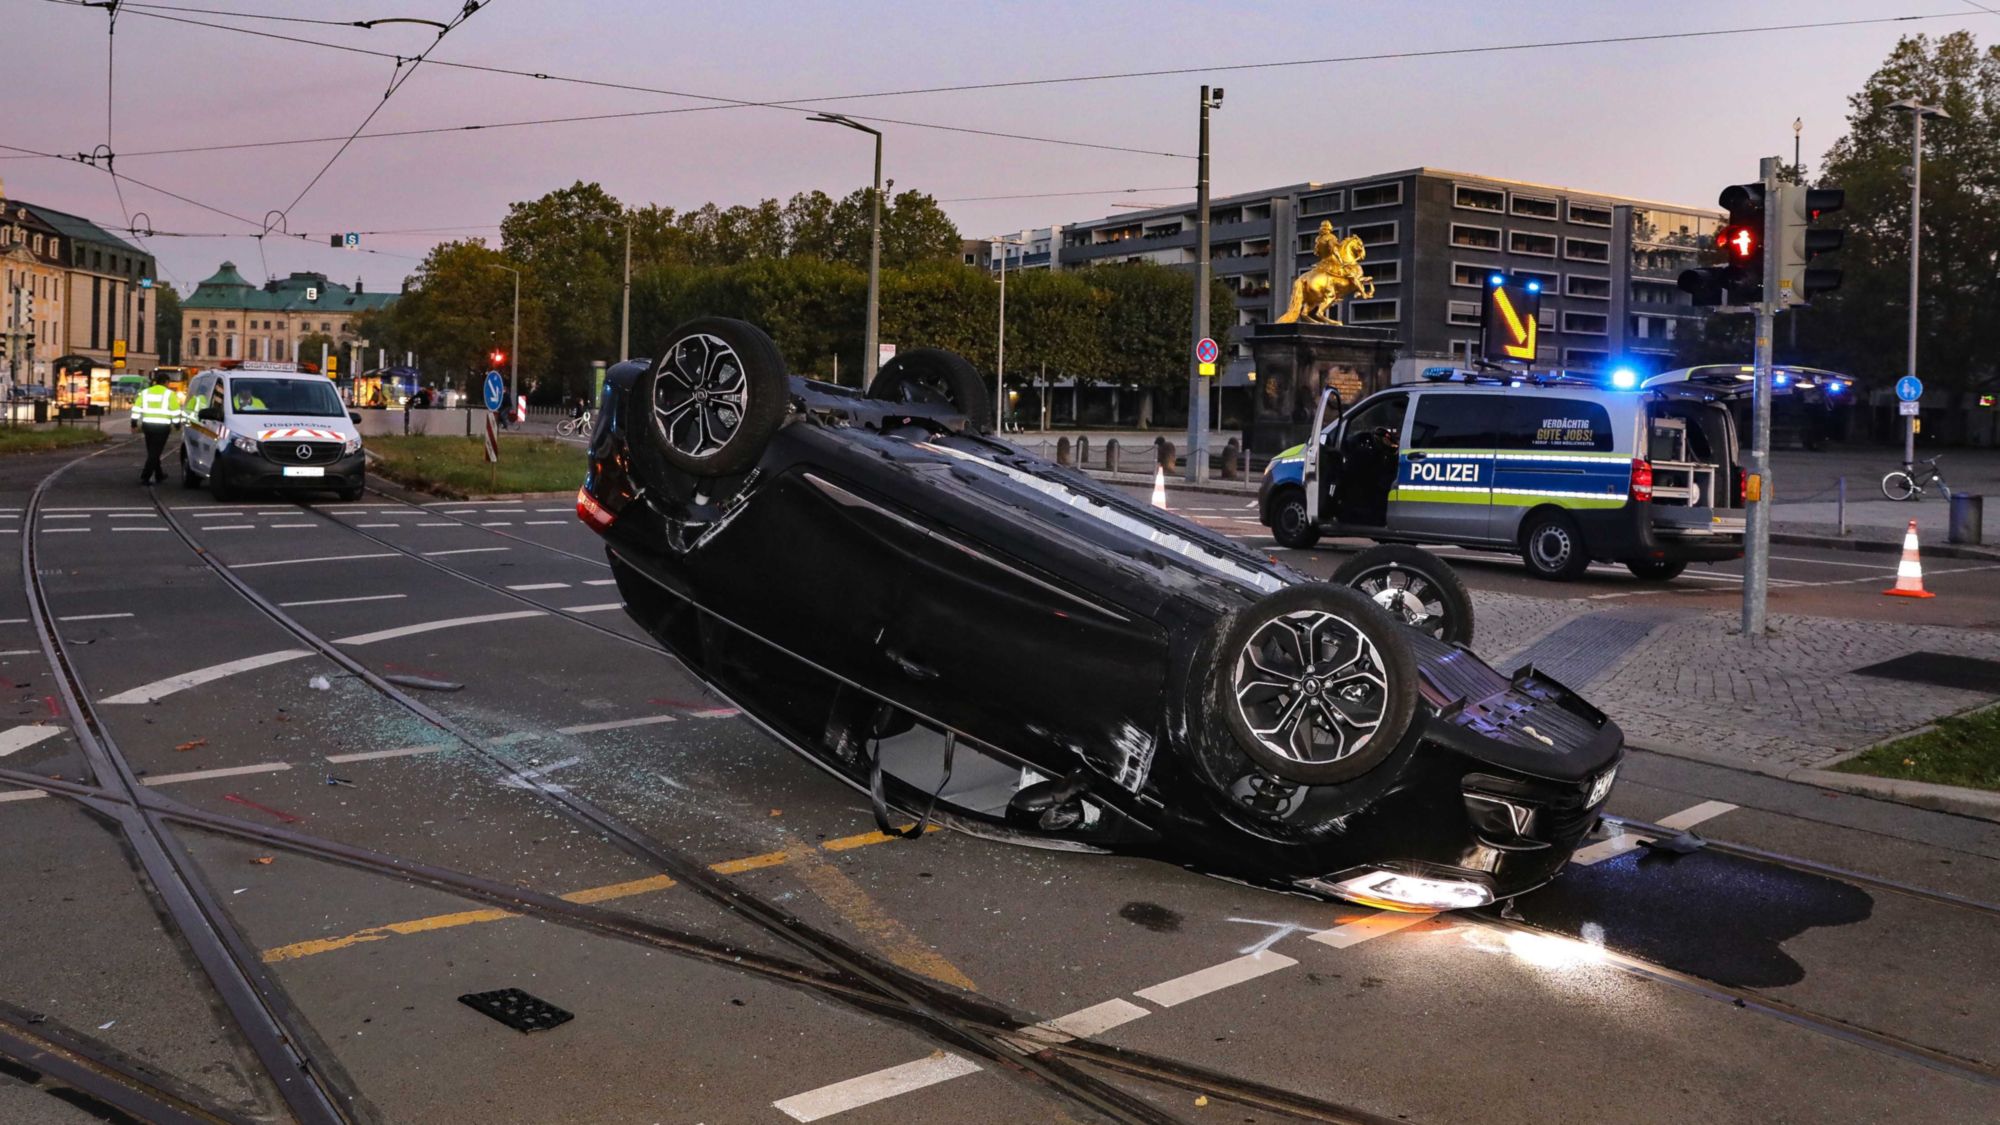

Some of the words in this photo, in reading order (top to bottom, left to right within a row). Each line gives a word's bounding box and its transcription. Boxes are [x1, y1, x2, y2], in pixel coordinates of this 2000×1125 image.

[348, 235, 356, 245] S
[308, 289, 315, 298] E
[1542, 417, 1590, 428] VERDÄCHTIG
[1537, 429, 1561, 440] GUTE
[1564, 430, 1593, 441] JOBS!
[1410, 462, 1479, 482] POLIZEI
